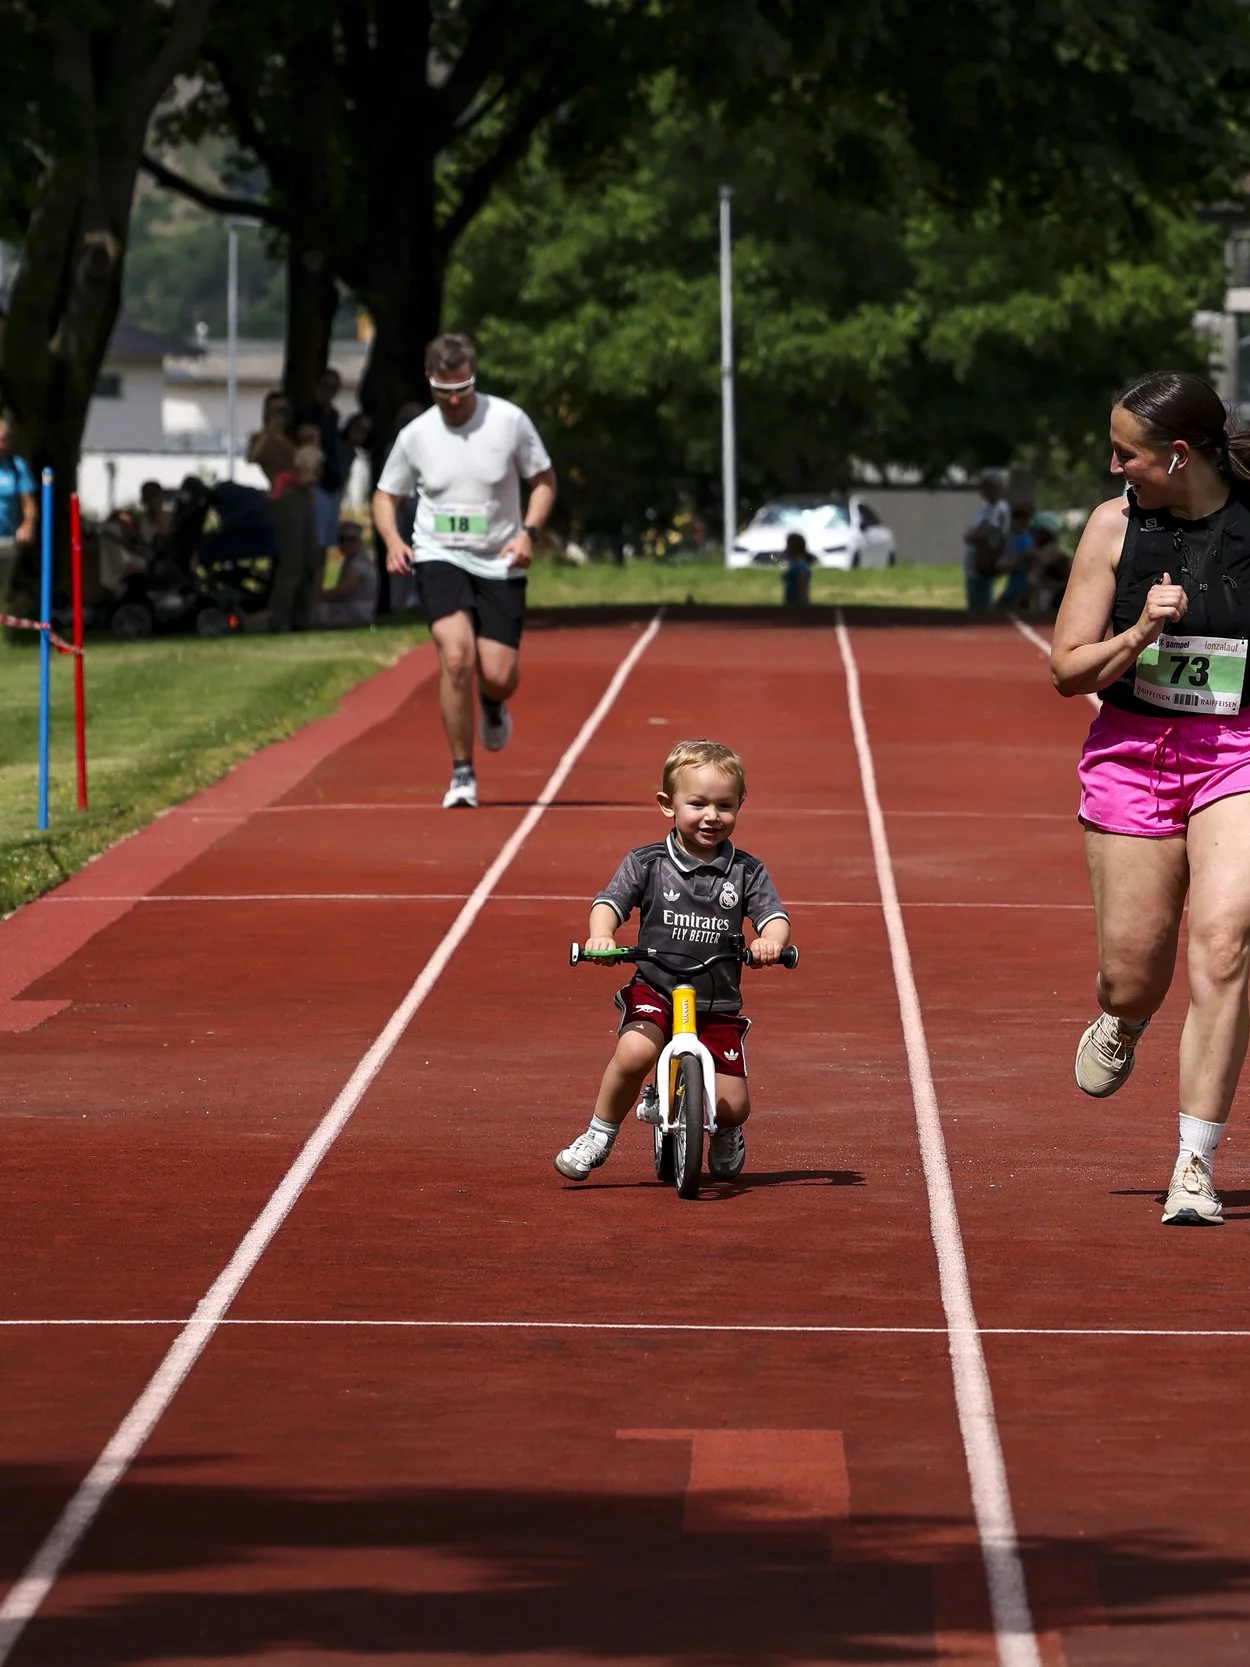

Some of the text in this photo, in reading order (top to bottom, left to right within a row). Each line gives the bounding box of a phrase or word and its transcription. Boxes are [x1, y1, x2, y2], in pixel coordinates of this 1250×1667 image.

[449, 516, 469, 532] 18
[1204, 640, 1239, 652] lonzalauf
[1169, 656, 1210, 686] 73
[1137, 686, 1237, 708] RAIFFEISEN RAIFFEISEN
[663, 909, 730, 931] Emirates
[671, 927, 721, 944] FLY BETTER
